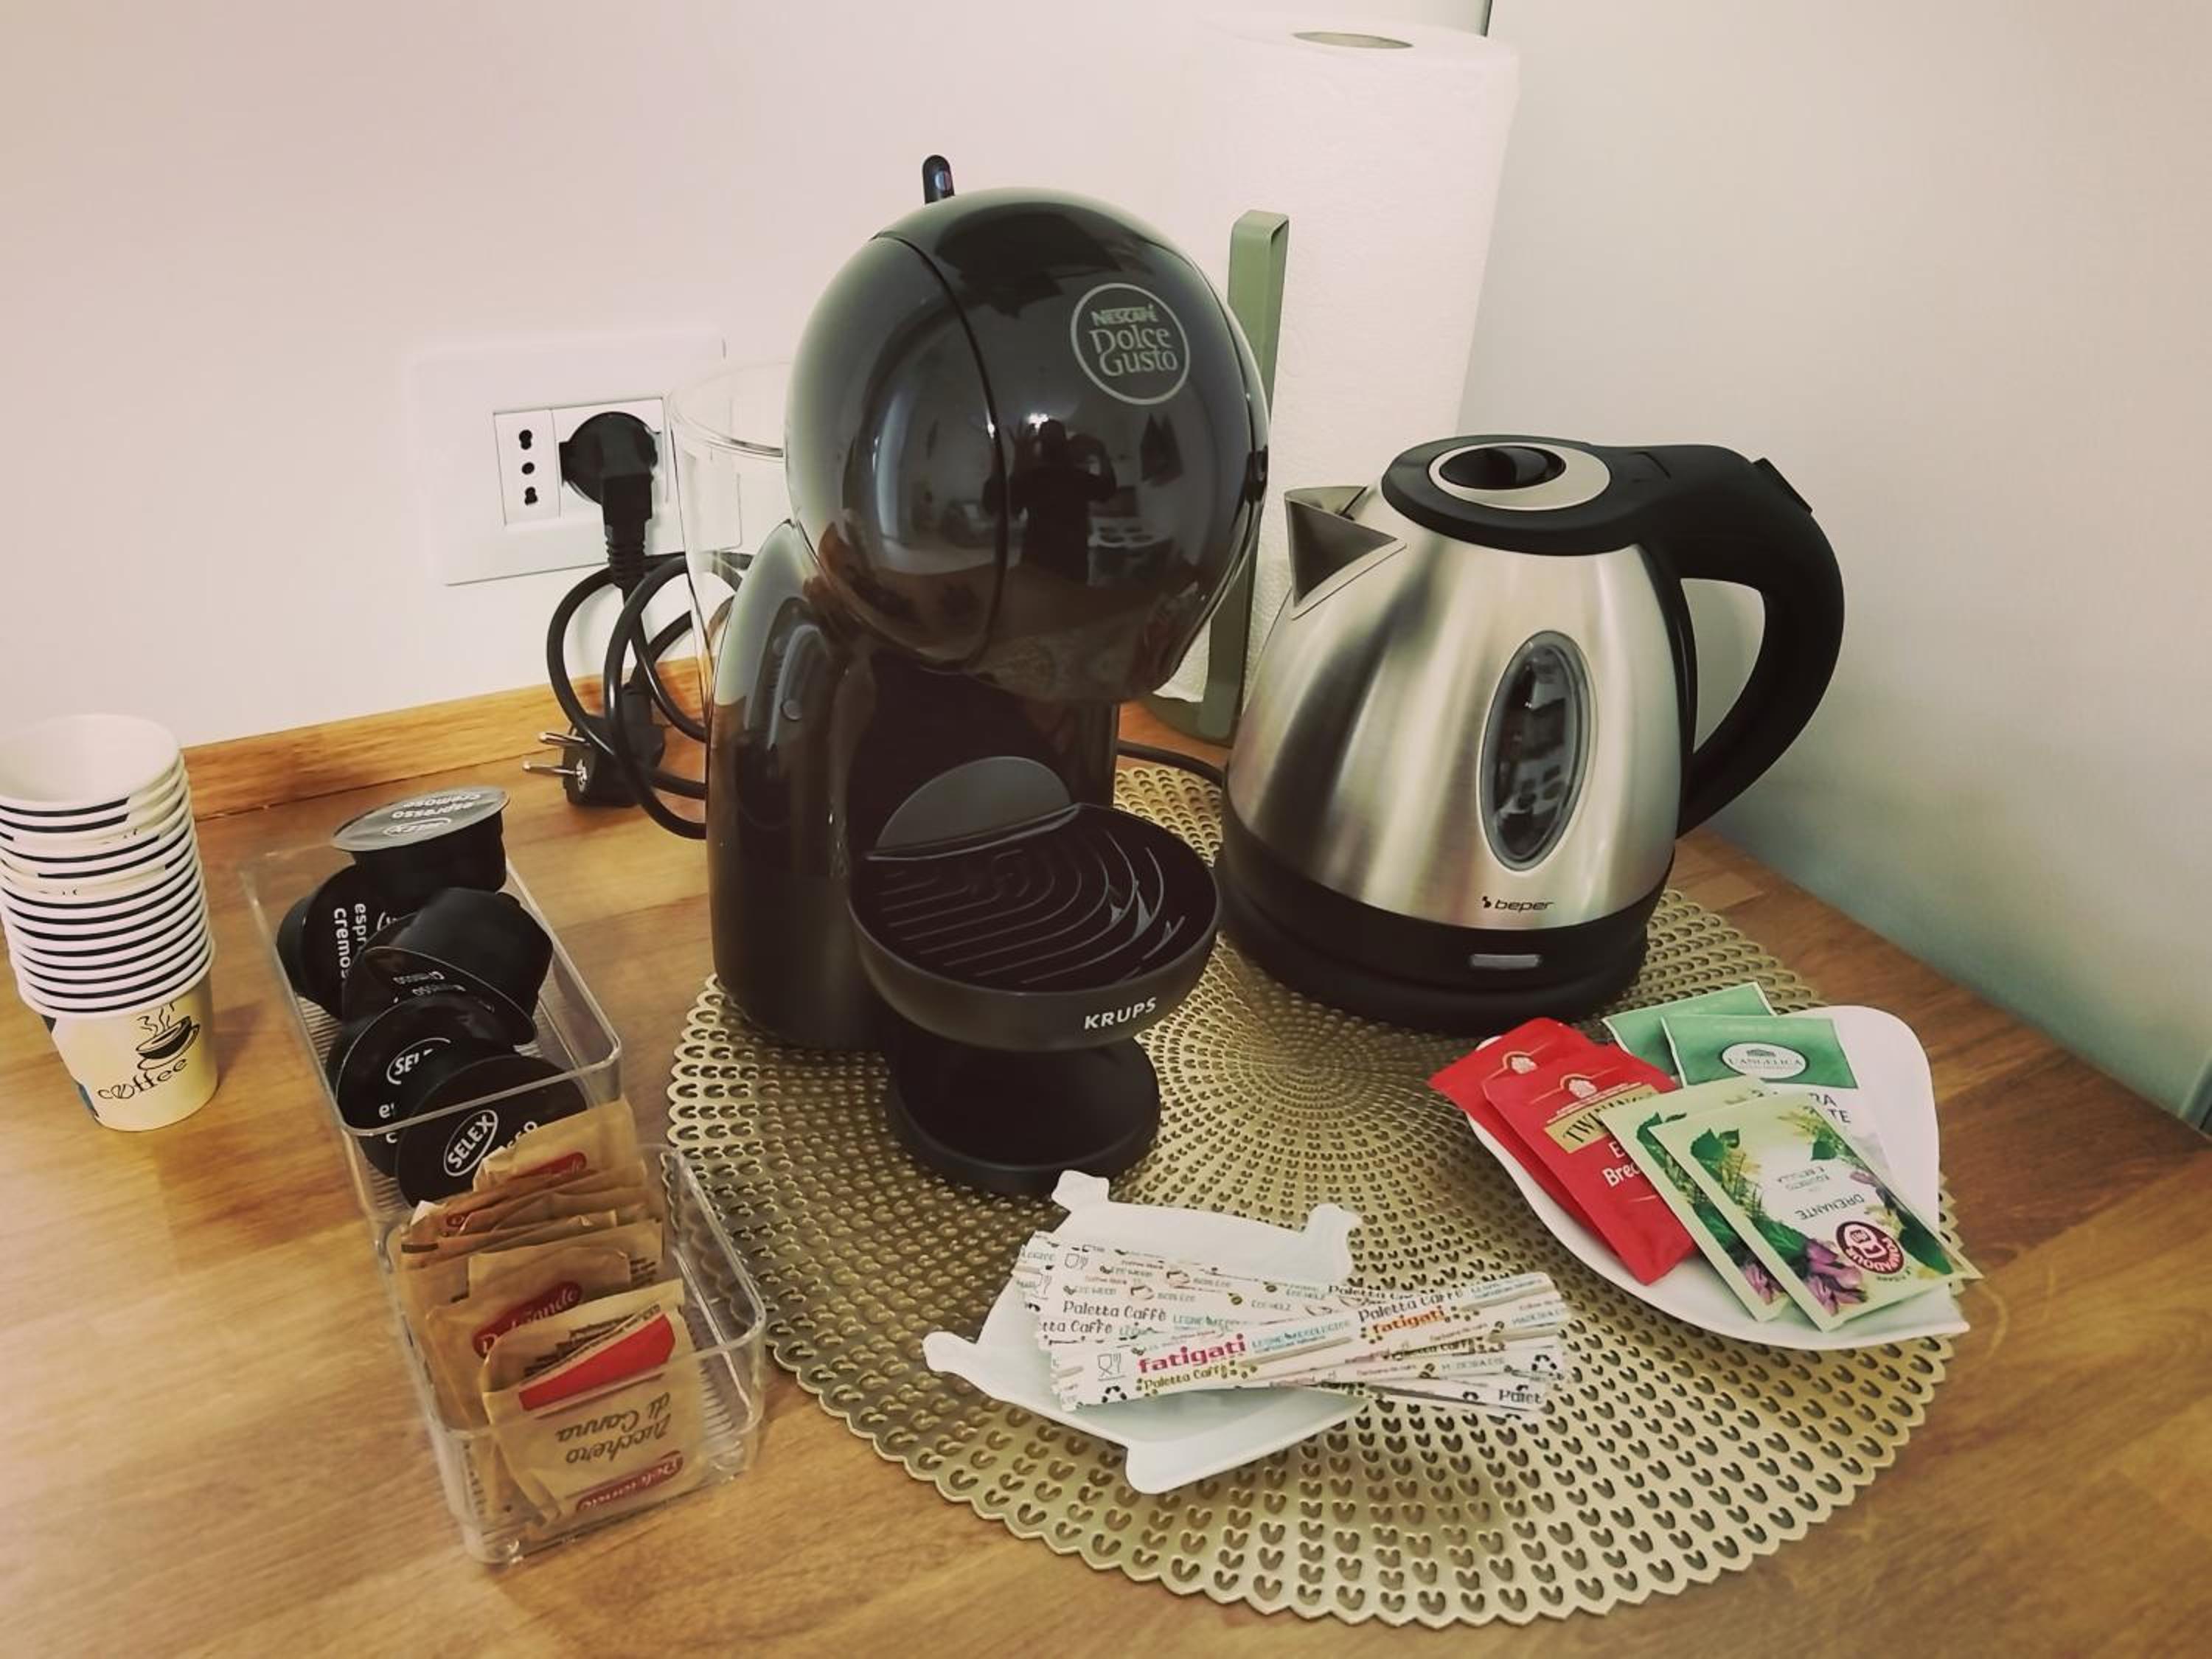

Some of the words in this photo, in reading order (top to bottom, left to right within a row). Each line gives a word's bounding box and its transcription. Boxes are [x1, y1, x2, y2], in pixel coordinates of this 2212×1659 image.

[1089, 324, 1172, 354] Dolce
[1099, 347, 1178, 377] Gusto
[1495, 899, 1554, 914] beper
[1084, 996, 1156, 1029] KRUPS
[448, 1115, 495, 1169] SELEX
[1062, 1300, 1119, 1318] Paletta
[1123, 1305, 1166, 1322] Caffè
[1358, 1299, 1417, 1322] Paletta
[1372, 1305, 1446, 1335] fatigati
[1137, 1333, 1247, 1374] fatigati
[1144, 1374, 1191, 1391] Paletta
[555, 1410, 639, 1443] Canna
